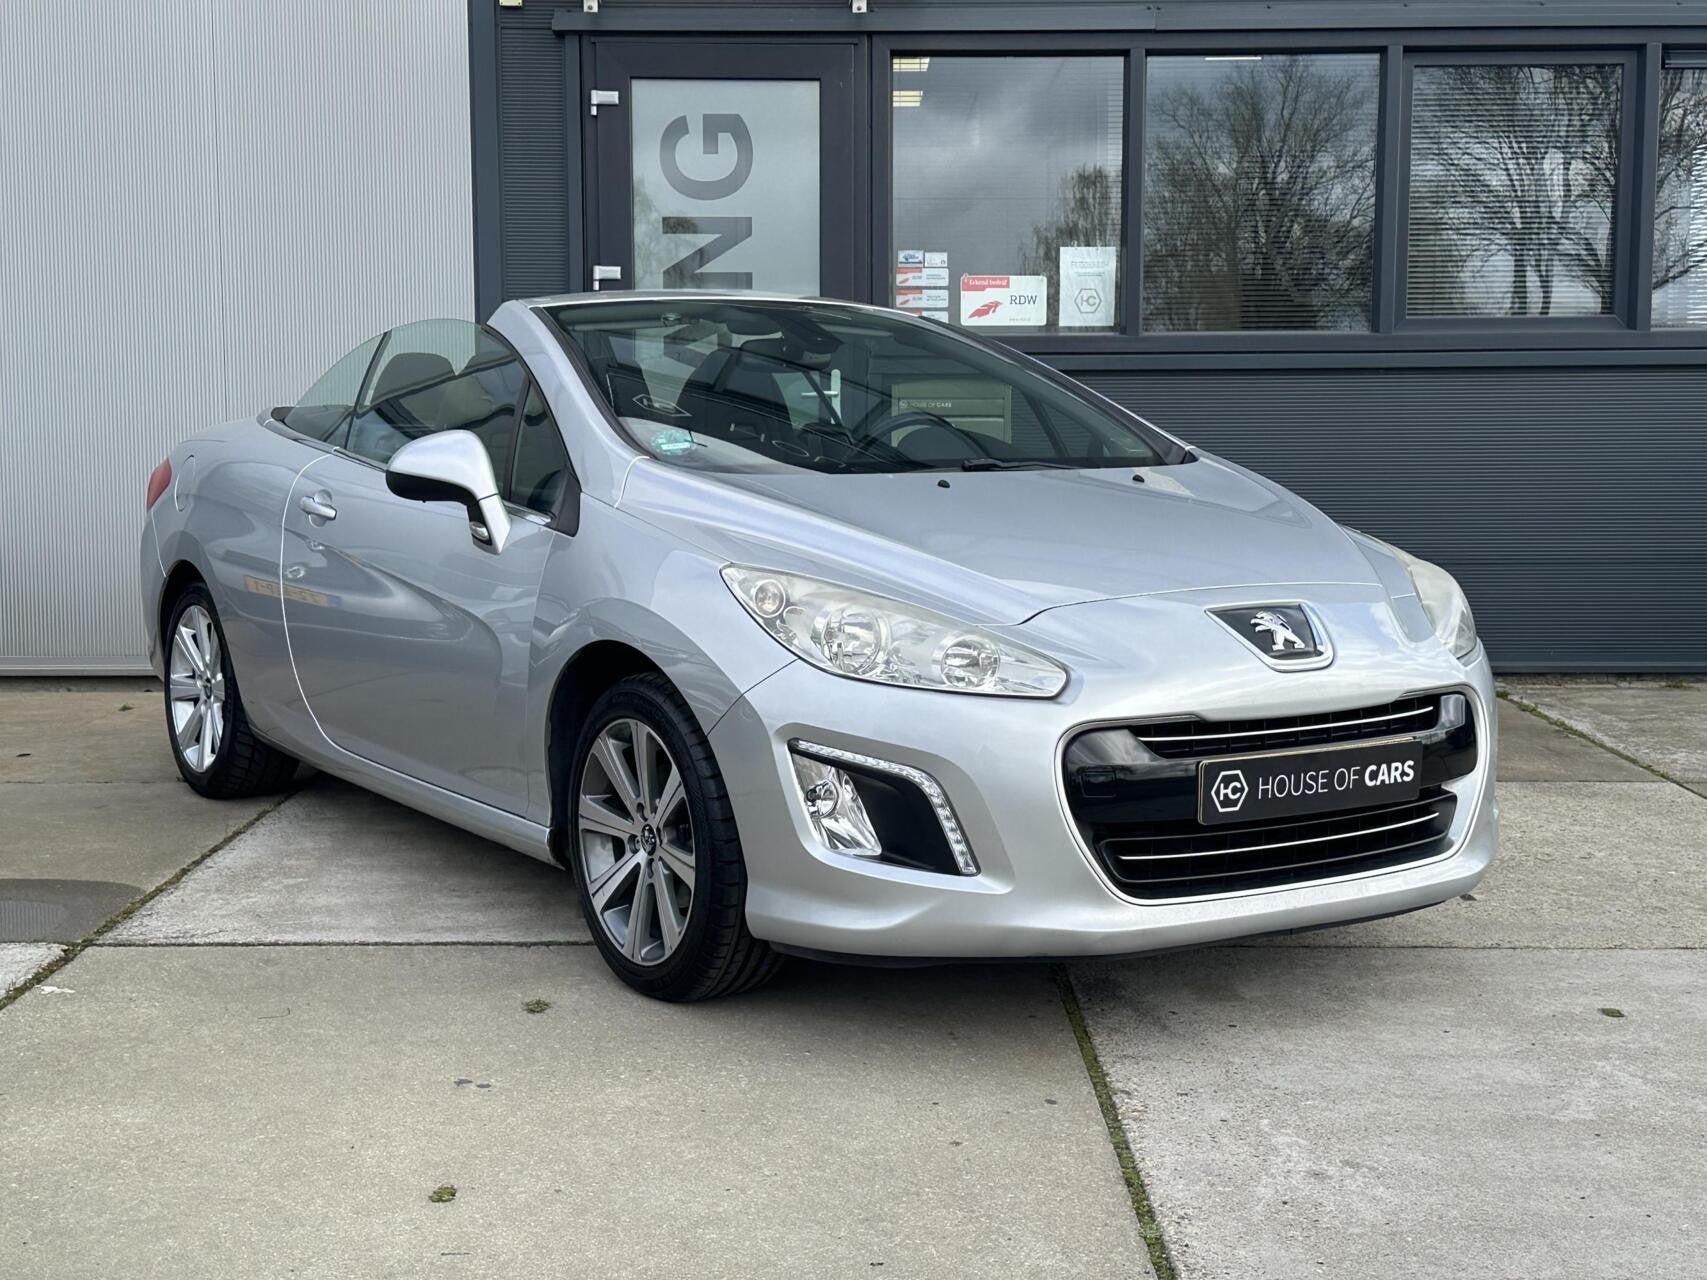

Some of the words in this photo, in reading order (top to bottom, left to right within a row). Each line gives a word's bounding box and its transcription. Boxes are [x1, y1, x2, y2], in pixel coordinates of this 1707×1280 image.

[1009, 295, 1038, 305] RDW
[1258, 770, 1330, 800] HOUSE
[1334, 766, 1361, 791] OF
[1364, 760, 1415, 787] CARS
